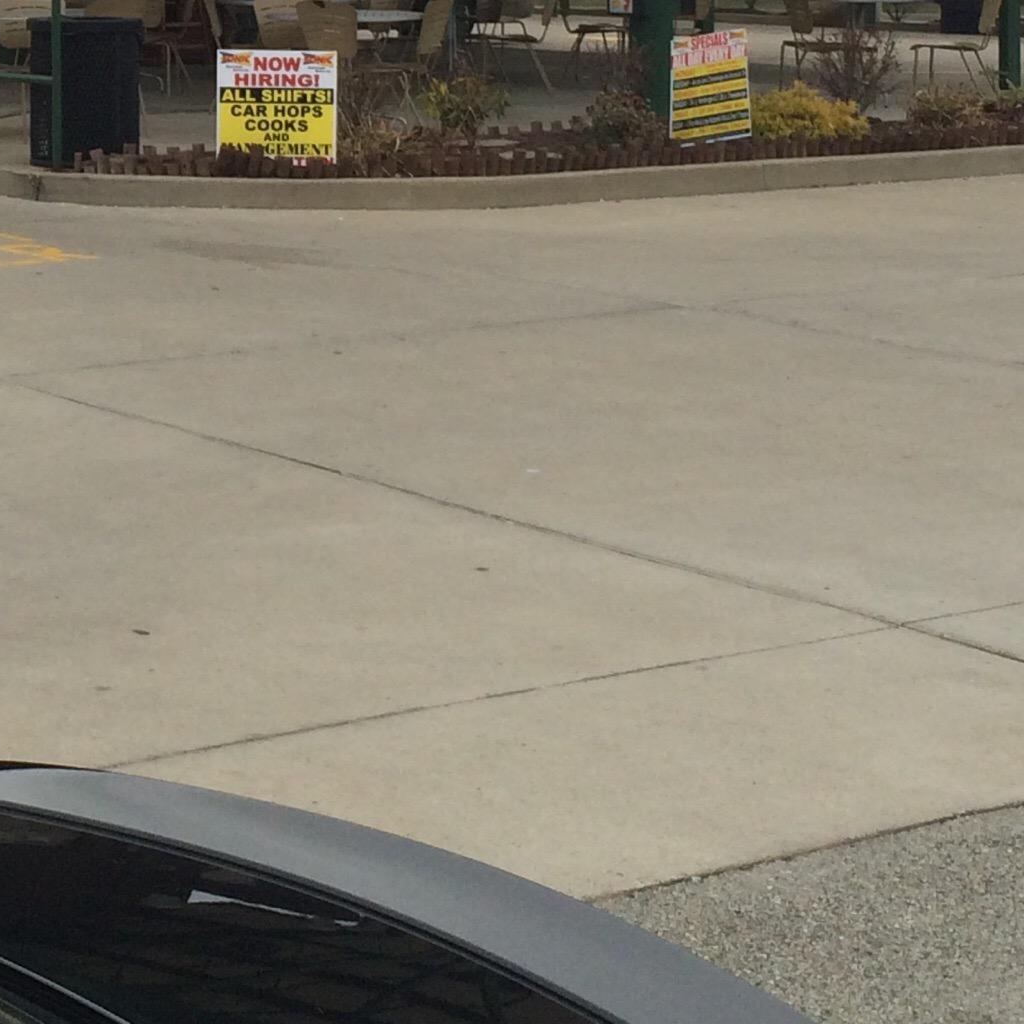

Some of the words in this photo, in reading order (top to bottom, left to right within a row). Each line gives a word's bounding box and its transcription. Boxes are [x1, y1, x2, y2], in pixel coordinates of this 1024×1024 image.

[253, 57, 301, 72] NOW
[234, 73, 320, 87] HIRING!
[222, 89, 256, 102] ALL
[261, 89, 332, 103] SHIFTS!
[231, 105, 267, 117] CAR
[273, 106, 323, 118] HOPS
[245, 119, 308, 132] COOKS
[263, 133, 290, 142] AND
